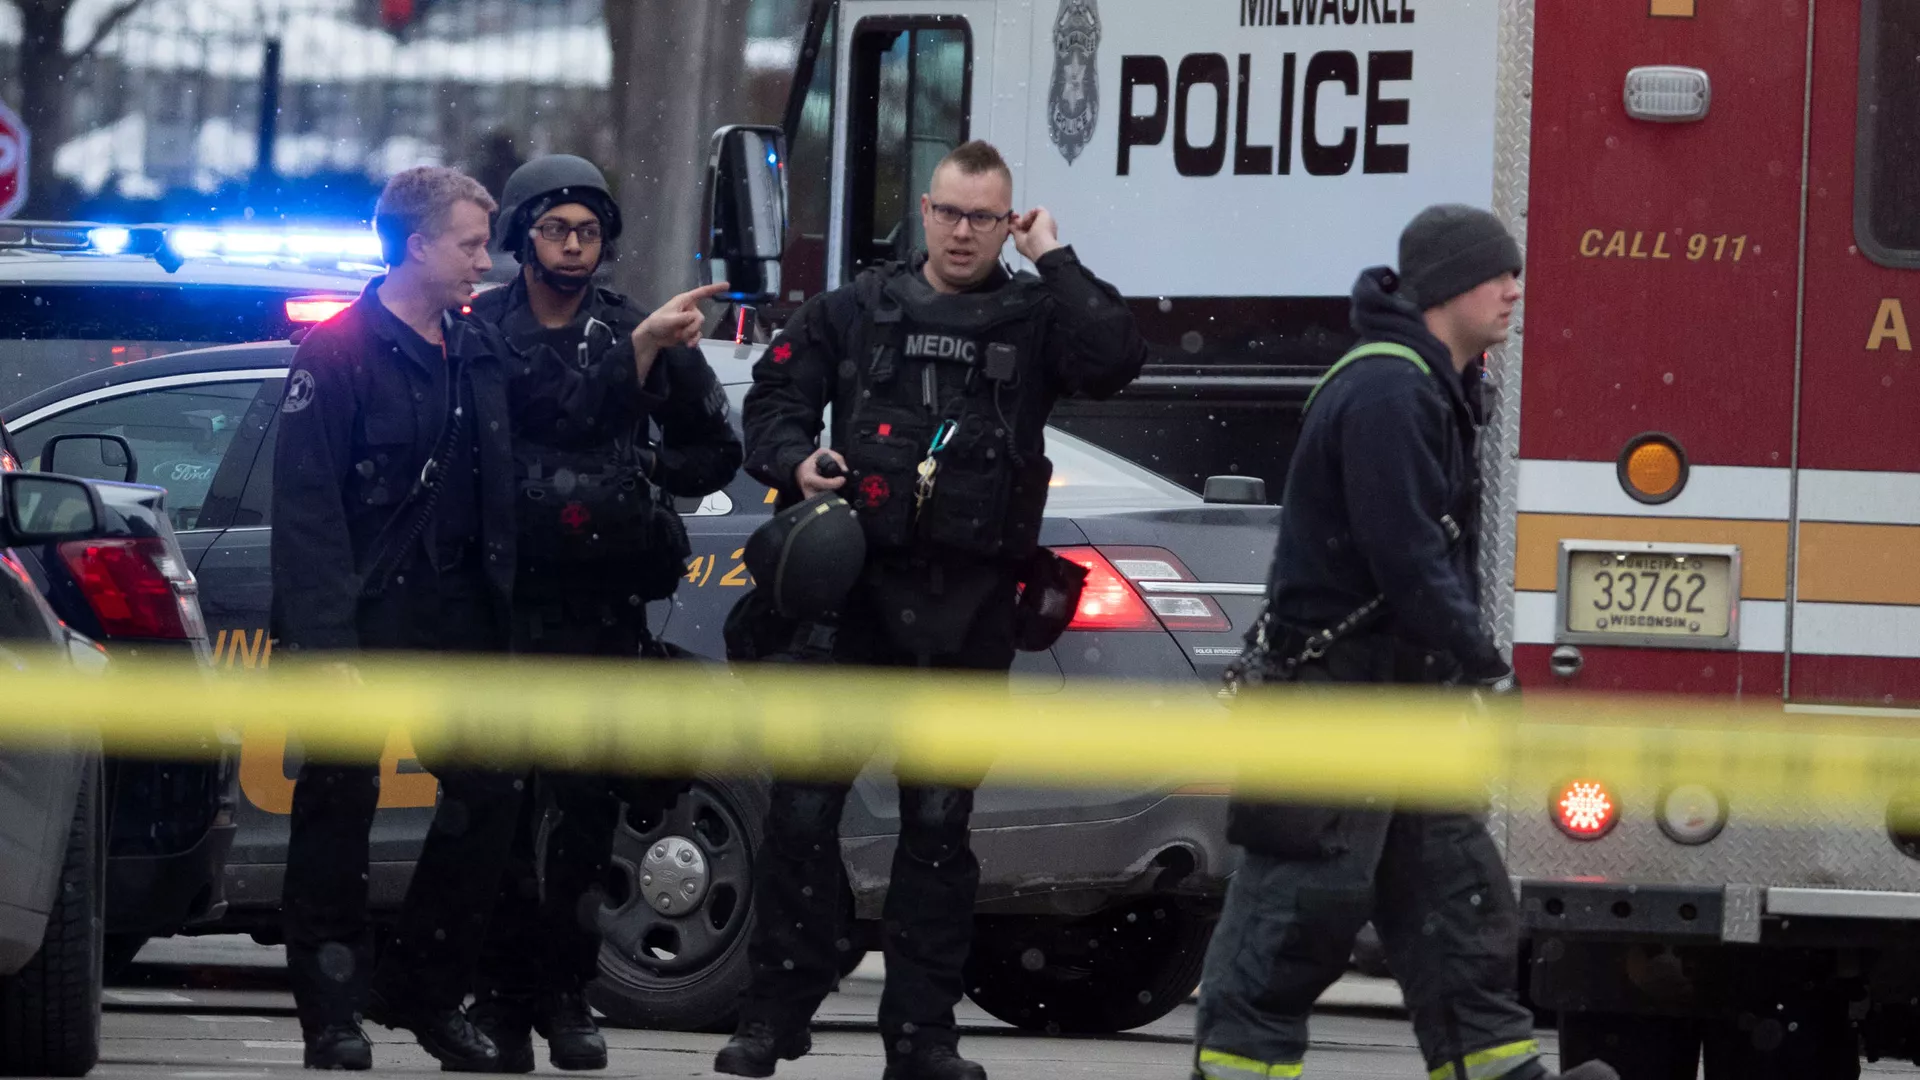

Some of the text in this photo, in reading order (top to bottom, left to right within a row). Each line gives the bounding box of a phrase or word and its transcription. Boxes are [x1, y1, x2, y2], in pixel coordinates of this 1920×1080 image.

[1055, 112, 1091, 134] POLICE
[1116, 50, 1413, 177] POLICE
[1579, 228, 1747, 262] CALL 911
[1865, 298, 1912, 351] A
[905, 334, 976, 363] MEDIC
[171, 463, 211, 481] Ford
[719, 547, 757, 586] 2
[1616, 559, 1688, 570] MUNICIPAL
[1594, 572, 1706, 613] 33762
[1611, 615, 1686, 627] WISCONSIN
